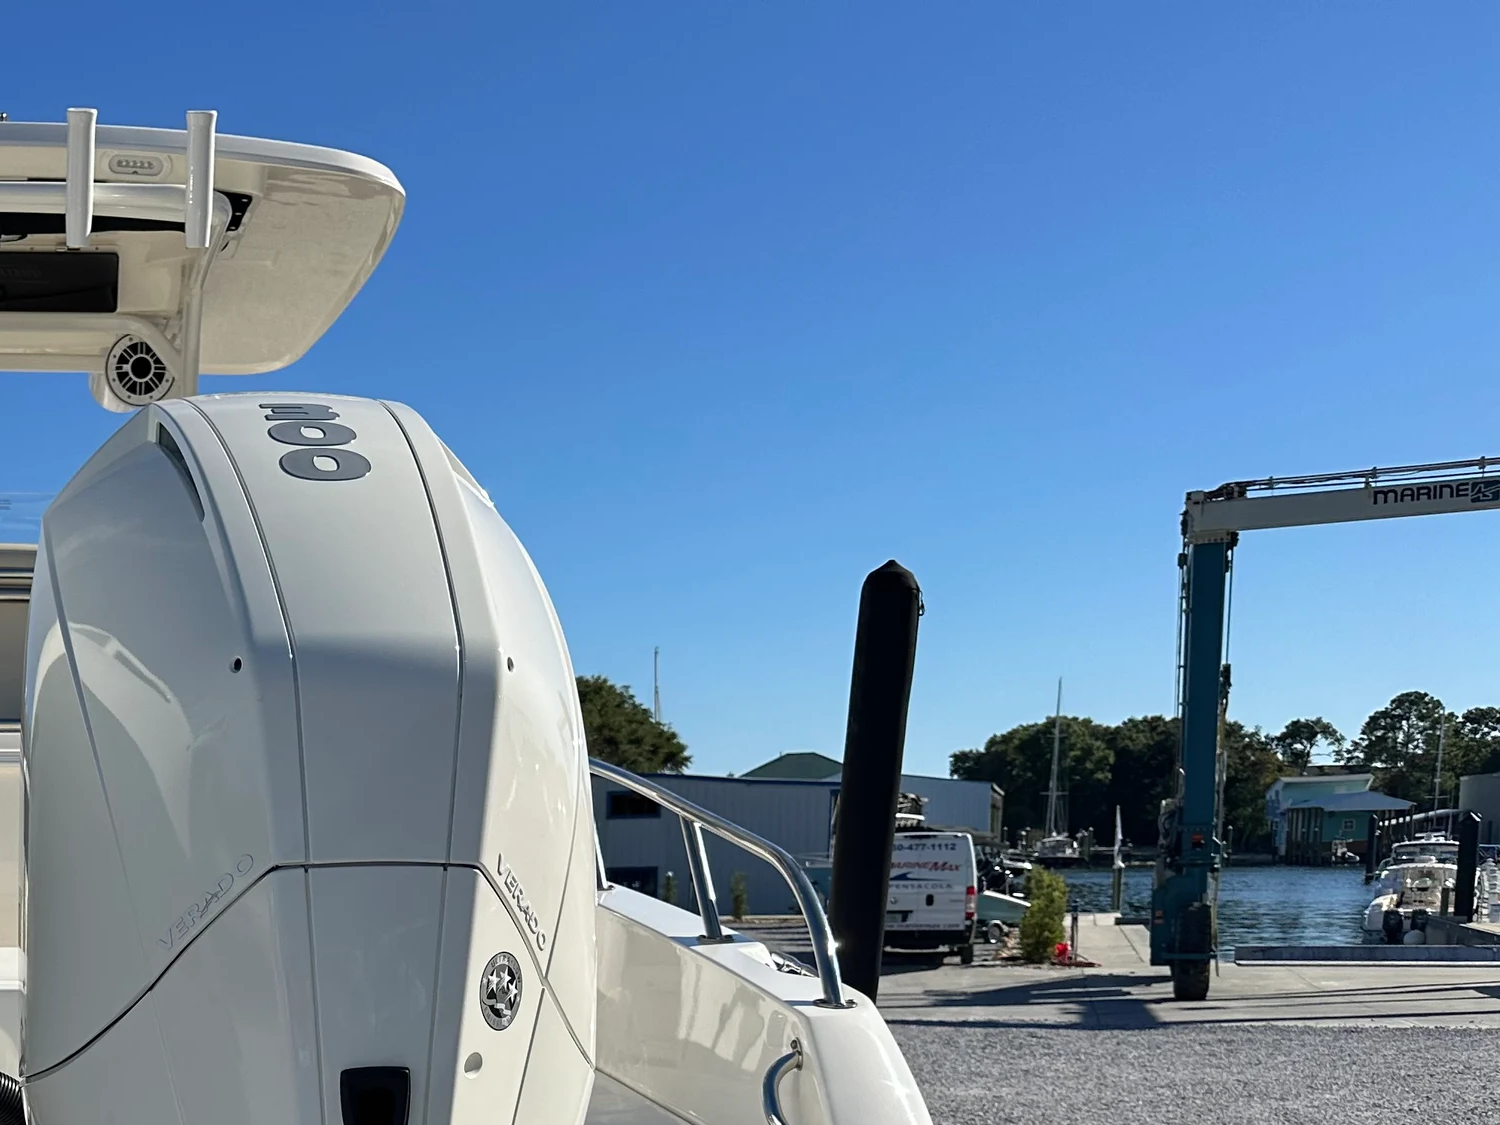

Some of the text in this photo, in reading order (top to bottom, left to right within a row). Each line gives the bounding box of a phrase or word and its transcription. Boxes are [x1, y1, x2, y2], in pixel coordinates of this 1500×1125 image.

[258, 403, 371, 481] 300
[1372, 482, 1470, 505] MARINE
[158, 853, 254, 951] VERADO
[497, 853, 546, 952] VERADO
